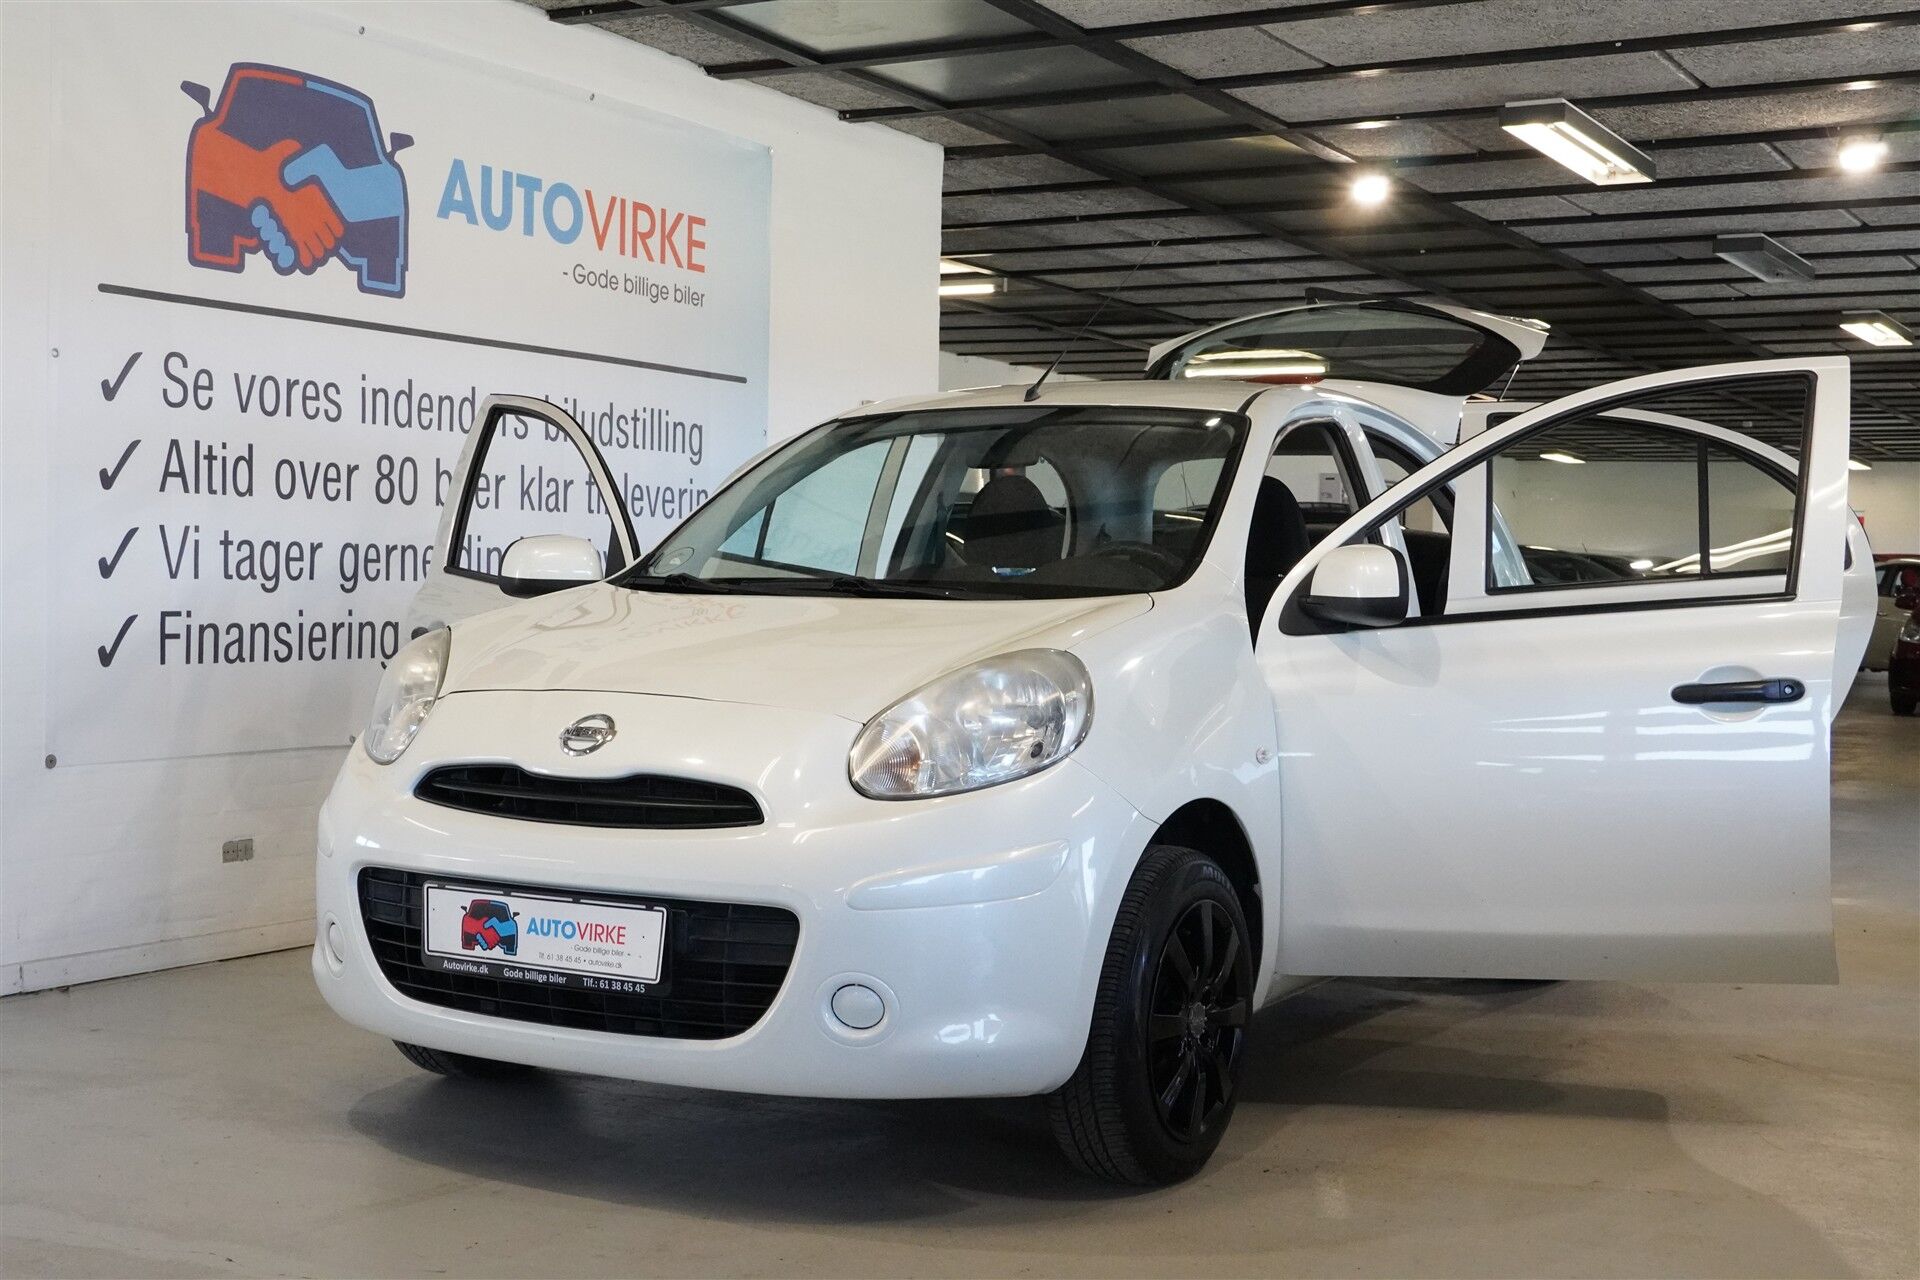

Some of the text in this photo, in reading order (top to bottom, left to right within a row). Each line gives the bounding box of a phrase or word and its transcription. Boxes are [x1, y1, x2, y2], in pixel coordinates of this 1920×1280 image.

[436, 157, 706, 274] AUTOVIRKE
[572, 262, 619, 291] Gode
[624, 273, 669, 304] billige
[674, 283, 705, 307] biler
[162, 351, 214, 411] Se
[233, 371, 343, 423] vores
[360, 373, 529, 440] indends
[159, 438, 254, 498] Altid
[274, 458, 360, 502] over
[374, 453, 418, 506] 80
[435, 457, 506, 510] ber
[520, 464, 574, 513] klar
[585, 471, 609, 515] ti
[158, 524, 200, 580] Vi
[218, 529, 323, 593] tager
[159, 608, 399, 670] Finansiering
[526, 917, 626, 946] AUTOVIRKE
[546, 953, 555, 961] 61
[556, 954, 564, 962] 38
[442, 958, 490, 976] Autovirke.dk
[503, 967, 524, 980] Gode
[524, 969, 549, 983] billige
[549, 972, 568, 985] biler
[599, 978, 610, 990] 61
[611, 979, 622, 992] 38
[622, 980, 634, 993] 45
[634, 981, 646, 994] 45
